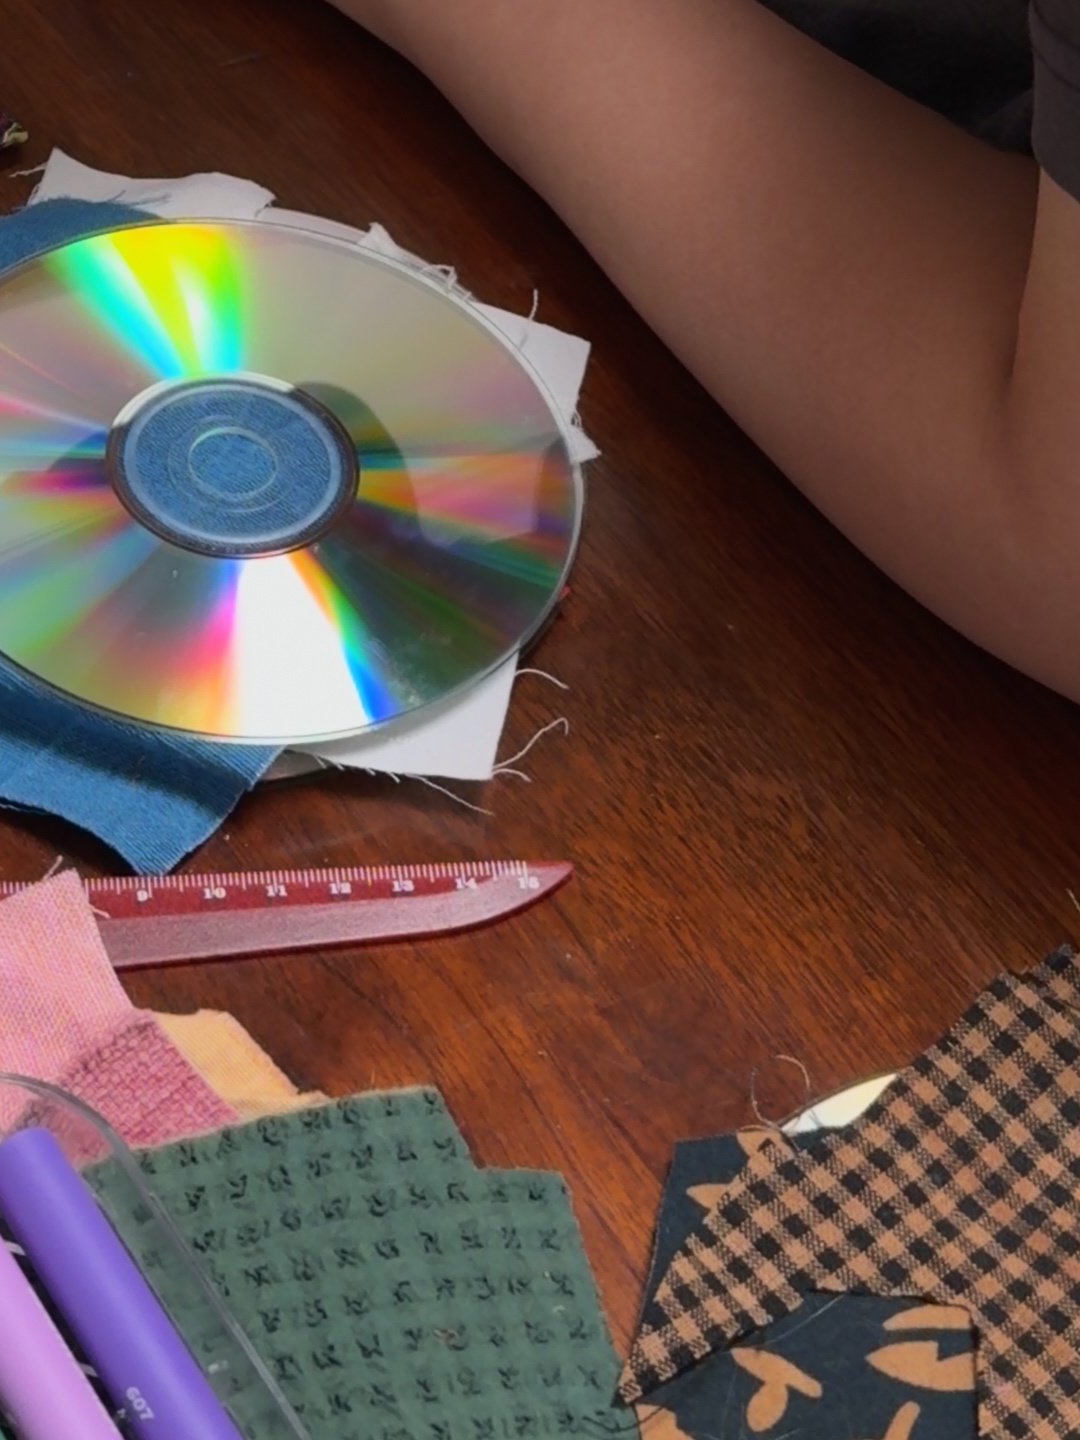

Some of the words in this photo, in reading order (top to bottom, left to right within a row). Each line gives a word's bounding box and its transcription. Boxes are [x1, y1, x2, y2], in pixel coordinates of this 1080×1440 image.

[204, 886, 227, 900] 10
[266, 884, 288, 898] 11
[329, 881, 352, 895] 12
[392, 879, 414, 893] 13
[455, 877, 477, 890] 14
[126, 1386, 155, 1421] 607
